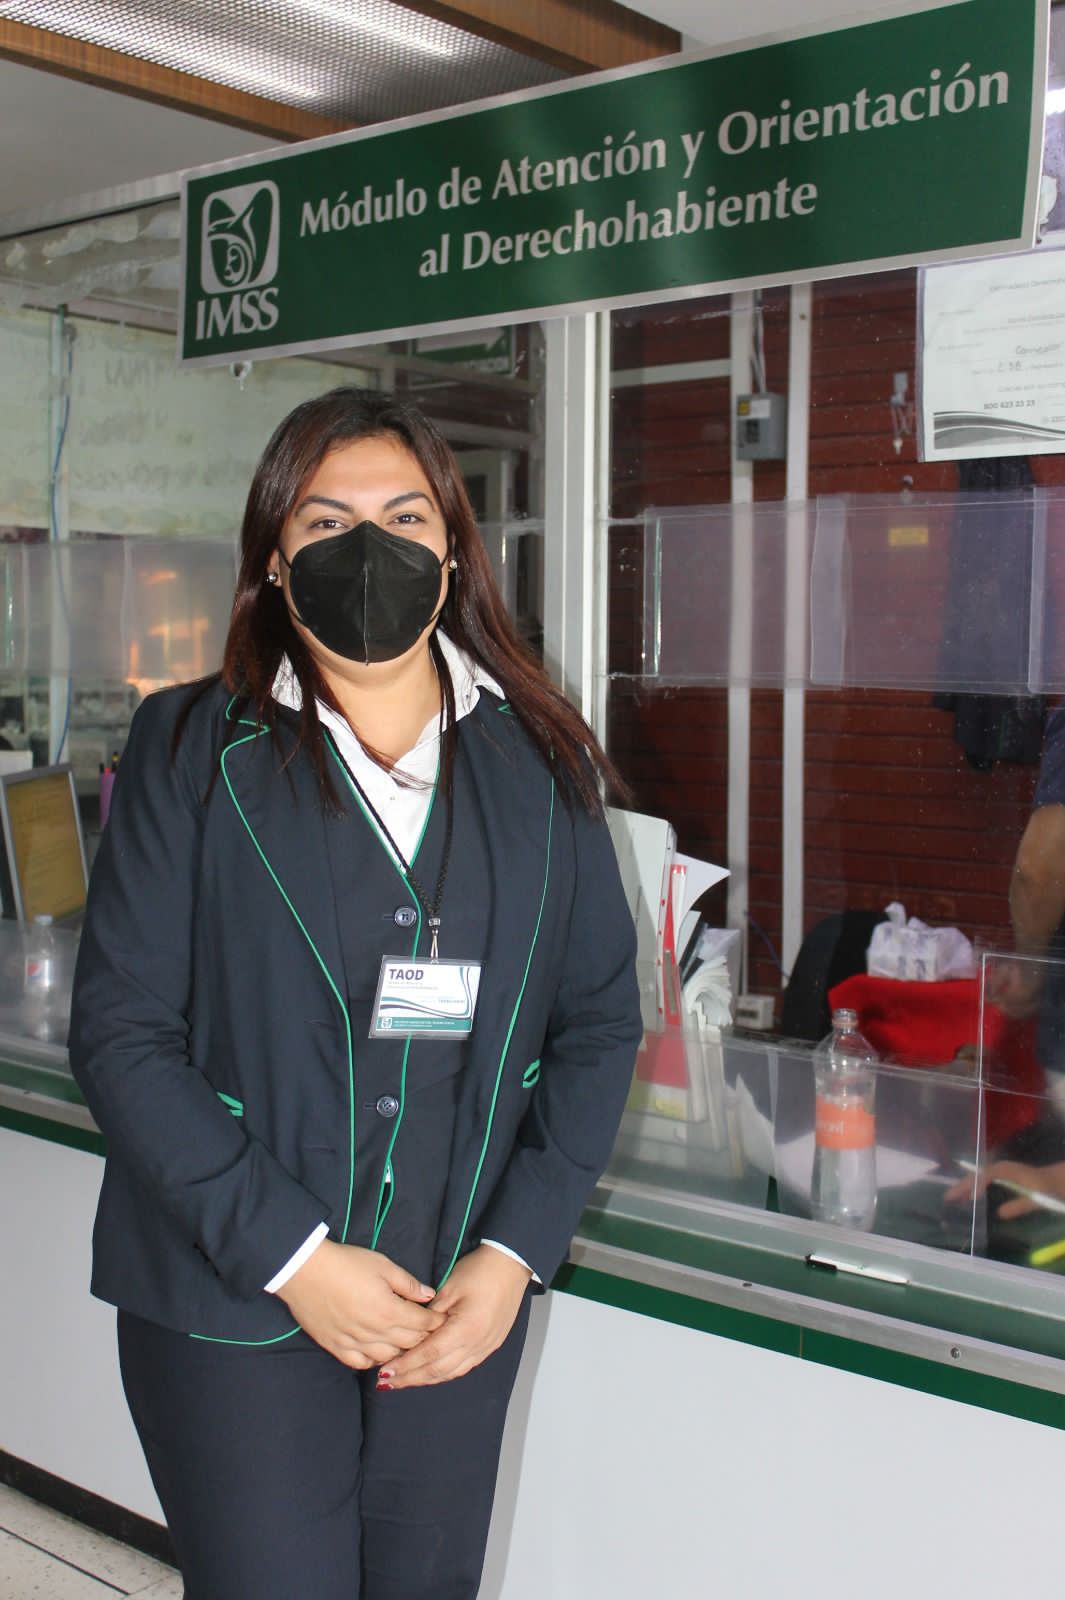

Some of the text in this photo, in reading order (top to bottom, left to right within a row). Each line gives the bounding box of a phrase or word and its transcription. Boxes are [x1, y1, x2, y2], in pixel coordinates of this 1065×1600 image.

[300, 62, 1009, 237] Módulo de Atención y Orientación
[419, 178, 818, 277] al Derechohabiente
[195, 287, 280, 340] IMSS
[388, 968, 424, 981] TAOD
